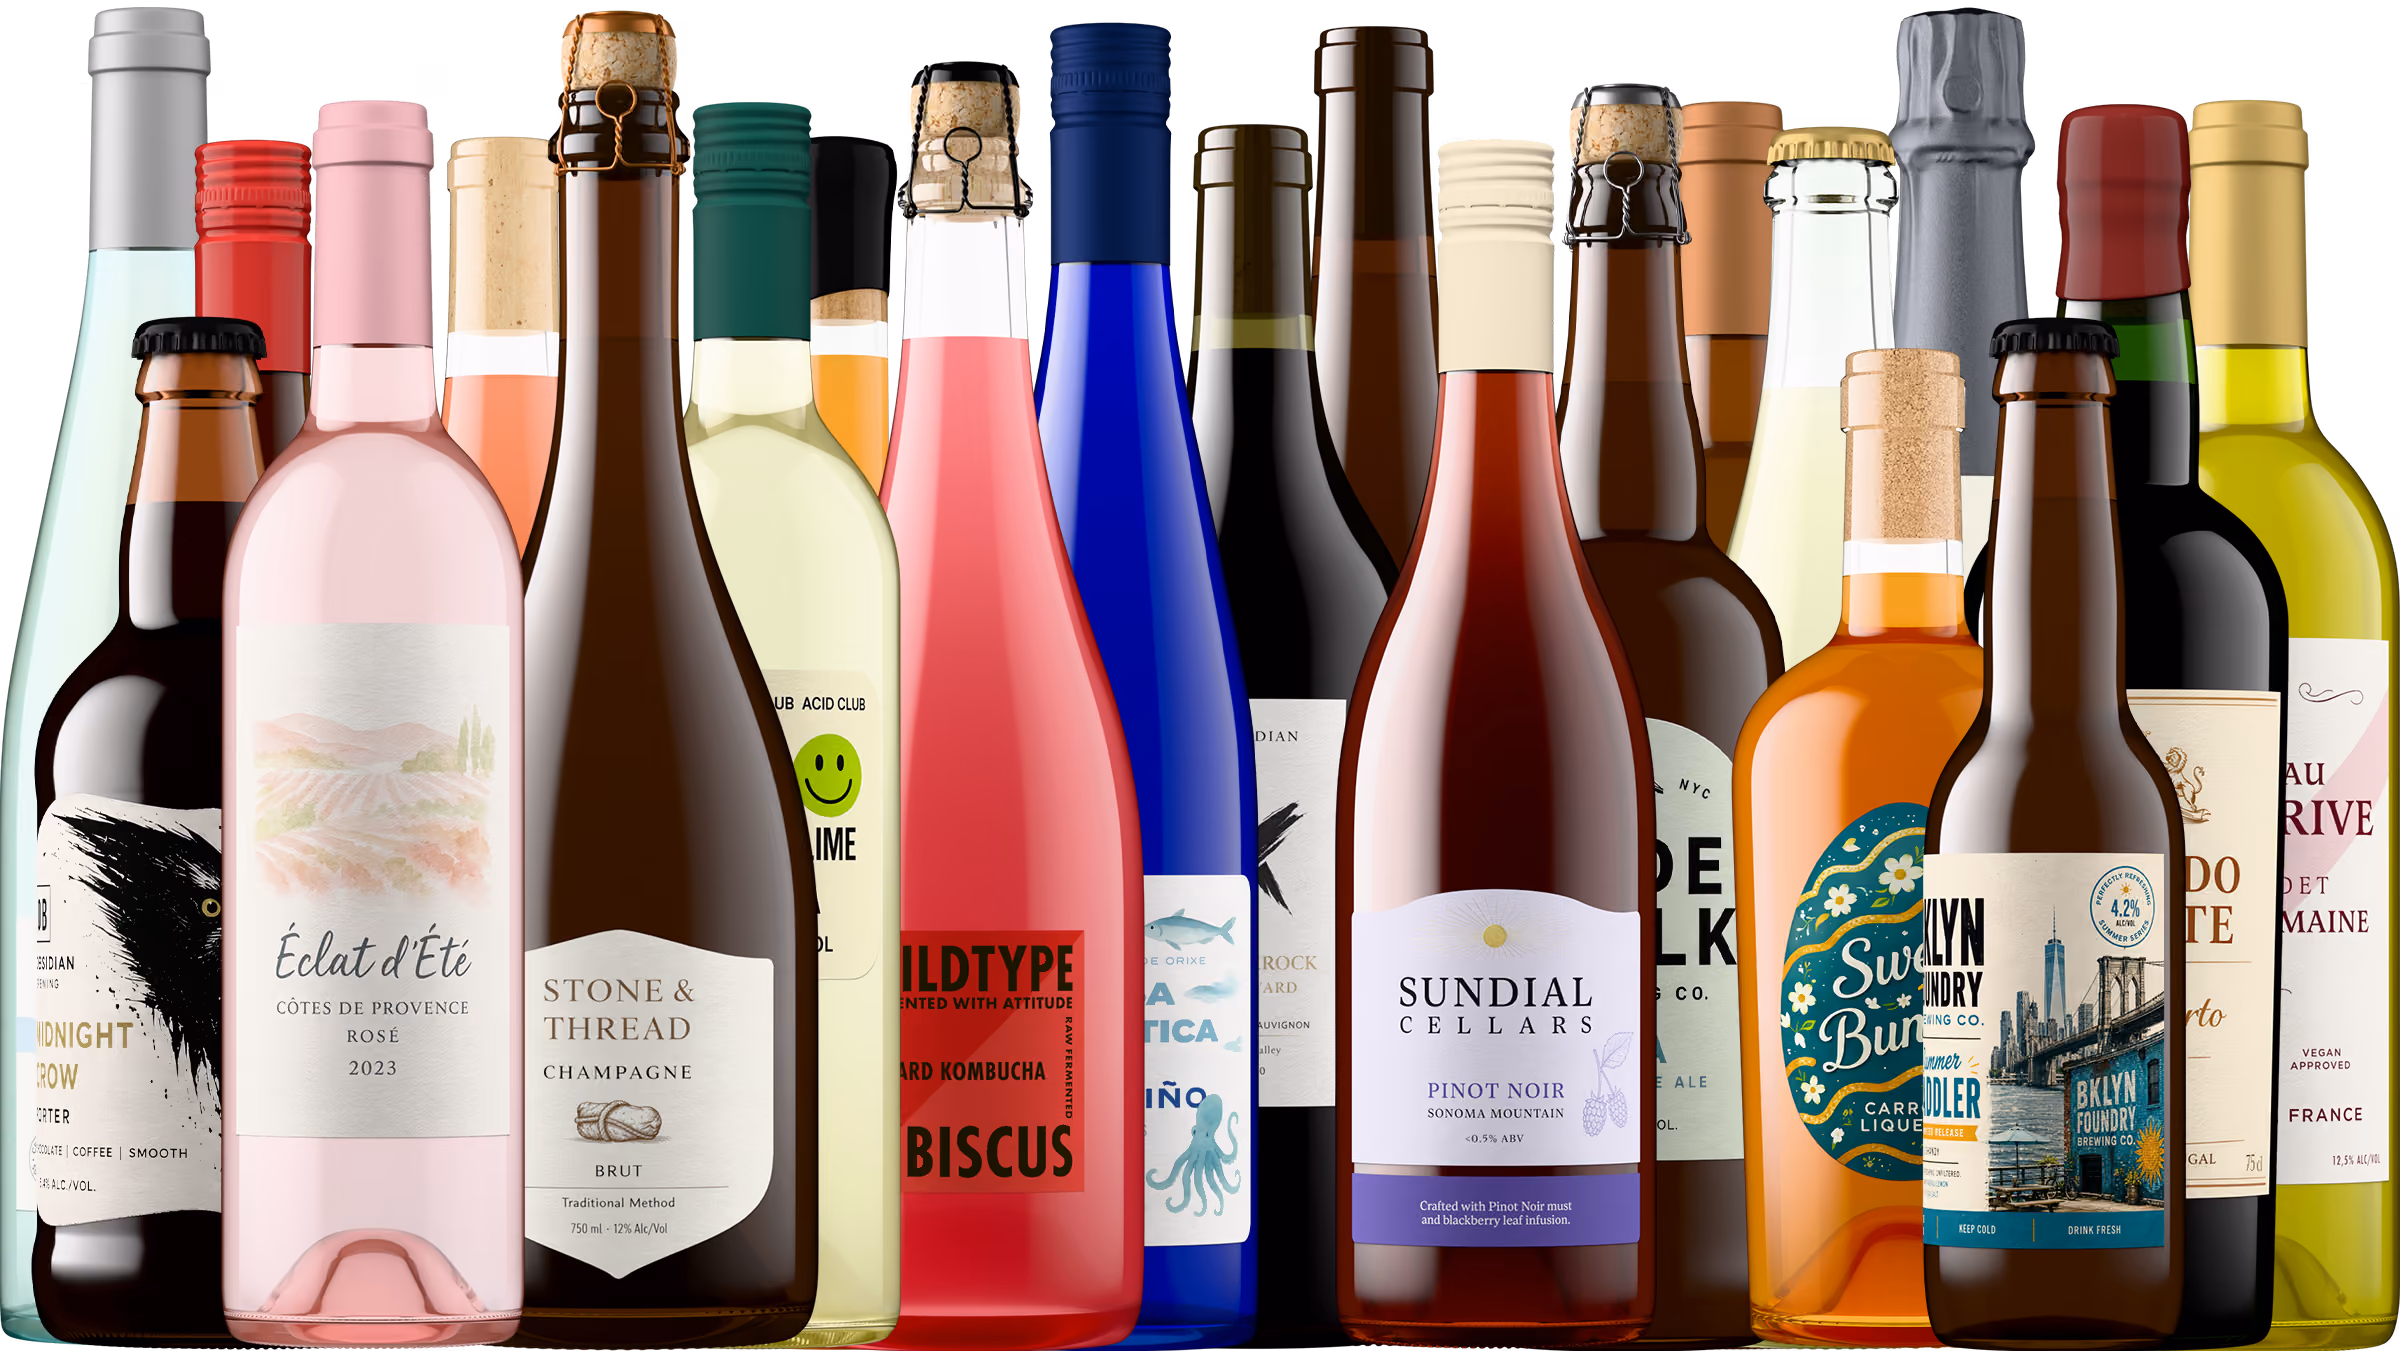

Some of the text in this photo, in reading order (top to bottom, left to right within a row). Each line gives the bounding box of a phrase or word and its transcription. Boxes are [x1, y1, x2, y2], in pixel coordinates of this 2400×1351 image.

[775, 697, 865, 710] UB ACID CLUB
[1256, 731, 1297, 741] DIAN
[2286, 761, 2326, 787] AU
[1680, 779, 1710, 799] NYC
[2285, 800, 2374, 836] RIVE
[814, 827, 857, 861] IME
[2185, 855, 2241, 894] DO
[2096, 873, 2151, 905] PERFECTLY REFRESHING
[2111, 899, 2139, 917] 4.2%
[2185, 905, 2234, 944] TE
[2282, 910, 2370, 933] MAINE
[2099, 920, 2149, 942] SUMMER SERIES
[276, 922, 471, 979] Éclat d'Été
[1166, 957, 1205, 965] ORIXE
[1258, 955, 1318, 970] ROCK
[902, 945, 1073, 992] ILDTYPE
[545, 979, 694, 1002] STONE &
[1143, 982, 1176, 1006] A
[1258, 981, 1298, 994] ARD
[1400, 977, 1592, 1007] SUNDIAL
[1676, 987, 1707, 1000] CO.
[1923, 972, 1983, 1007] UNDRY
[277, 998, 468, 1015] CÔTES DE PROVENCE
[953, 997, 996, 1009] WITH
[1003, 997, 1072, 1009] ATTITUDE
[1258, 1021, 1311, 1030] AUVIGNON
[1400, 1016, 1591, 1034] CELLARS
[1957, 1015, 1984, 1025] CO.
[348, 1027, 398, 1042] ROSÉ
[544, 1017, 690, 1040] THREAD
[1144, 1019, 1219, 1043] TICA
[2303, 1049, 2340, 1057] VEGAN
[350, 1061, 396, 1075] 2023
[544, 1066, 691, 1079] CHAMPAGNE
[941, 1062, 1046, 1080] KOMBUCHA
[2291, 1061, 2350, 1070] APPROVED
[1675, 1076, 1706, 1088] ALE
[1429, 1083, 1564, 1098] PINOT NOIR
[2076, 1069, 2137, 1110] BKLYN
[37, 1108, 71, 1124] ORTER
[1428, 1109, 1563, 1118] SONOMA MOUNTAIN
[1865, 1102, 1923, 1116] CARR
[2290, 1108, 2362, 1122] FRANCE
[2077, 1106, 2136, 1134] FOUNDRY
[1466, 1135, 1497, 1143] <0.5%
[1934, 1127, 1965, 1138] RELEASE
[2077, 1134, 2138, 1148] BREWING CO.
[73, 1147, 112, 1157] COFFEE
[130, 1148, 187, 1158] SMOOTH
[907, 1125, 1072, 1178] BISCUS
[2188, 1154, 2216, 1164] GAL
[2357, 1154, 2380, 1166] ALC/VOL
[596, 1165, 642, 1177] BRUT
[563, 1197, 674, 1207] Traditional Method
[1420, 1200, 1571, 1211] Crafted with Pinot Noir must
[1422, 1215, 1570, 1227] and blackberry leaf infusion.
[571, 1223, 667, 1235] 750 ml 12% Alc/Vol
[1959, 1224, 1995, 1234] KEEP COLD
[2069, 1225, 2120, 1234] DRINK FRESH
